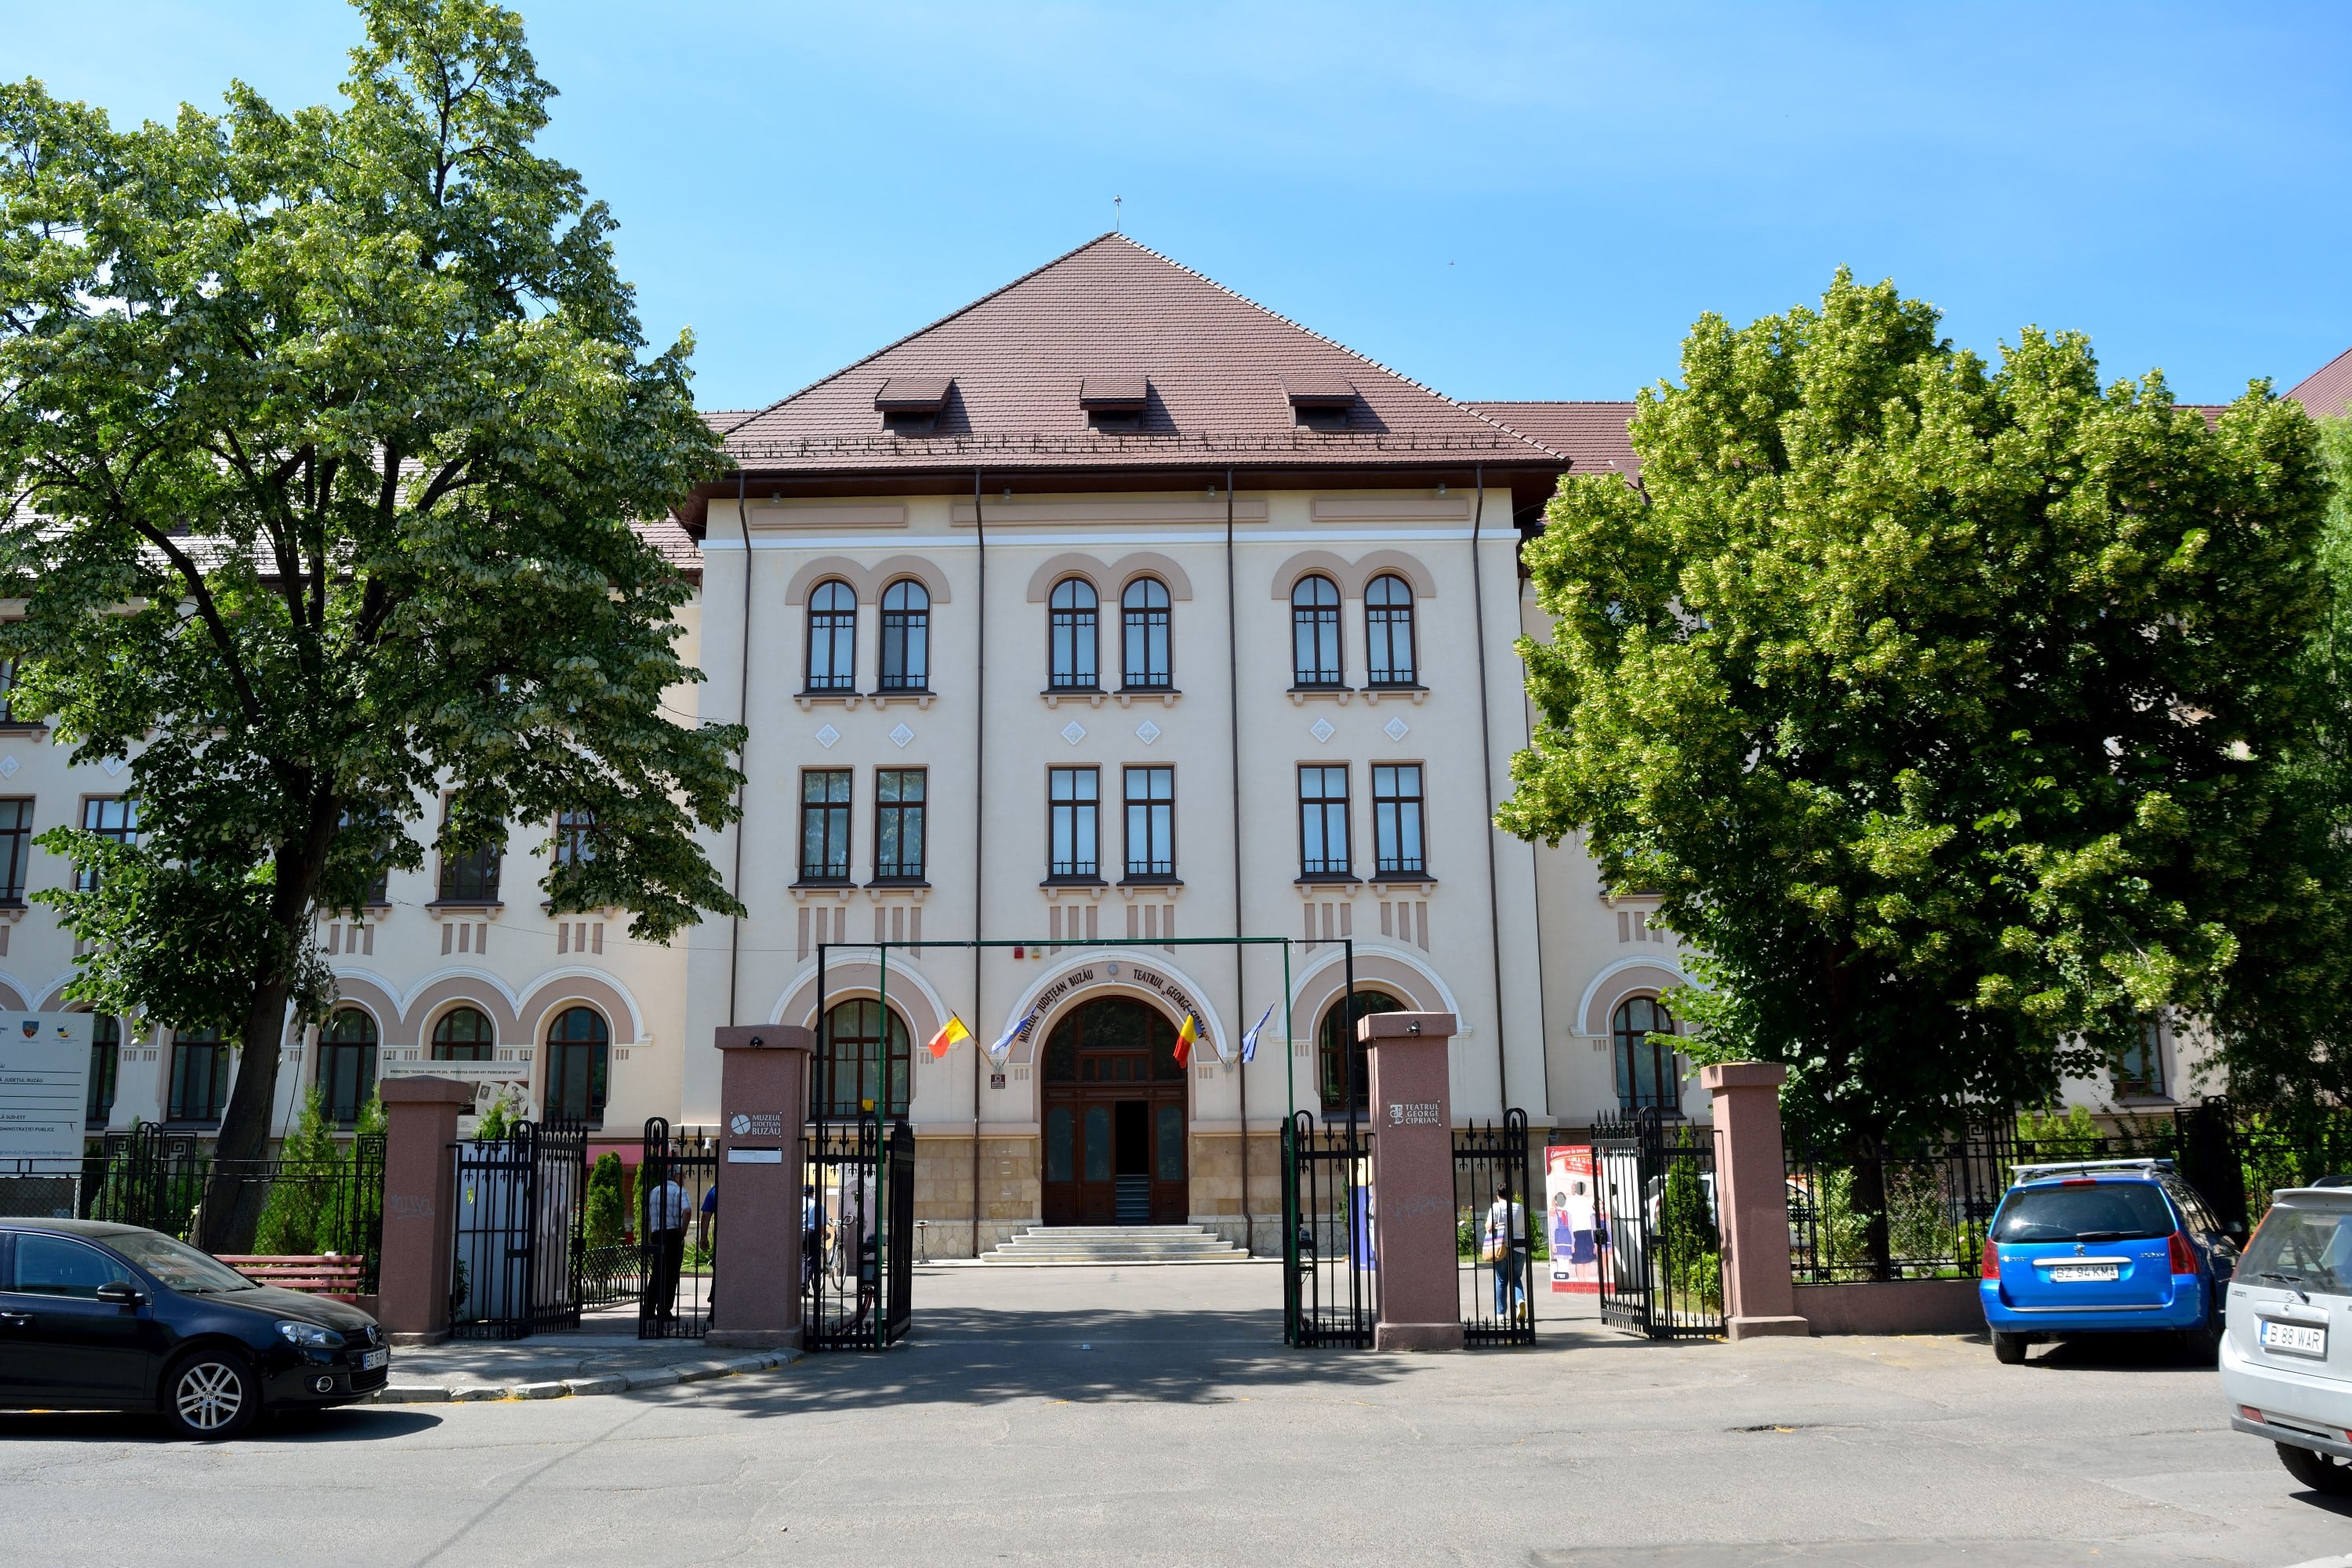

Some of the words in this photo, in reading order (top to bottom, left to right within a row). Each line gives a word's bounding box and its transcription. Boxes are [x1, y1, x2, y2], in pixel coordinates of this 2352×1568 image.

[1134, 969, 1164, 989] TEATRUL
[1019, 1014, 1040, 1044] MUZEUL
[1036, 982, 1068, 1014] JUDEȚEAN
[1068, 969, 1094, 987] BUZĂU
[2056, 1267, 2073, 1278] BZ
[2077, 1266, 2090, 1277] 94
[2092, 1265, 2116, 1276] KMA
[2270, 1325, 2278, 1342] B
[2281, 1327, 2294, 1345] 88
[2298, 1329, 2321, 1350] WAR
[367, 1355, 374, 1367] BZ
